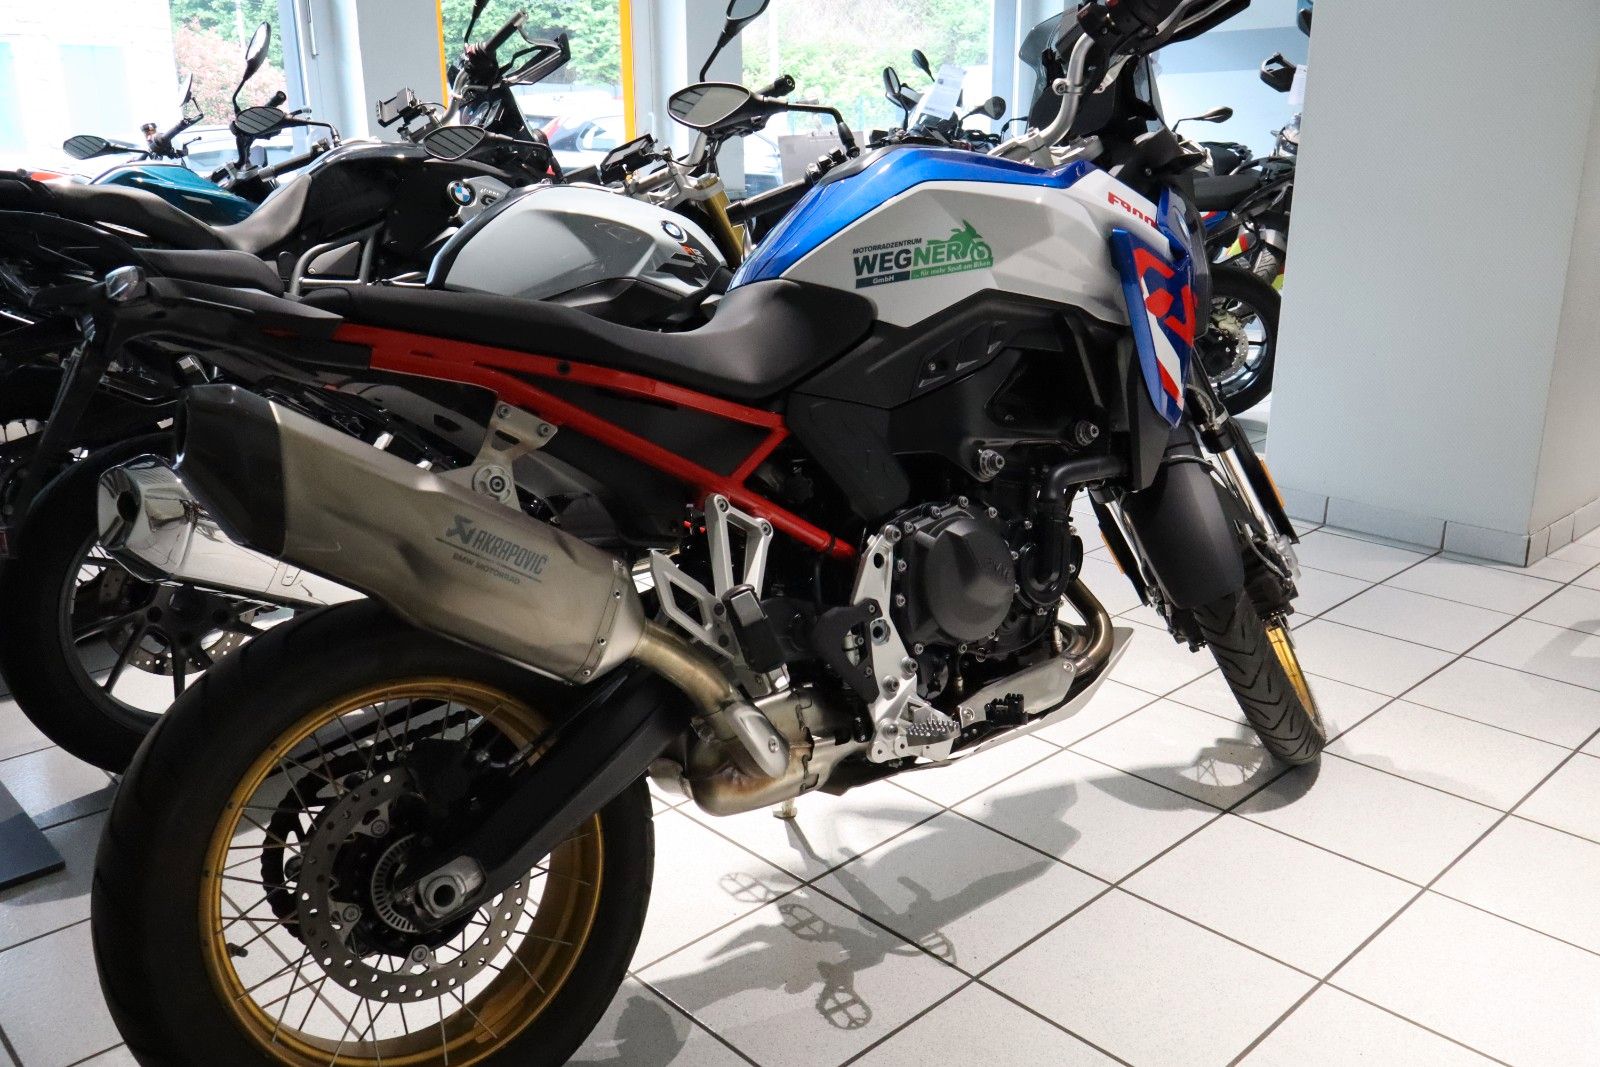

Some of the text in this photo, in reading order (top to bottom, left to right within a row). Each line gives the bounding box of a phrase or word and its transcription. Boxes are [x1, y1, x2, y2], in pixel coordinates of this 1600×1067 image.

[852, 238, 922, 254] MOTORRADZENTRUM
[853, 244, 963, 276] WEGNER
[872, 276, 895, 284] GmbH
[453, 552, 521, 585] BMW MOTORRAD
